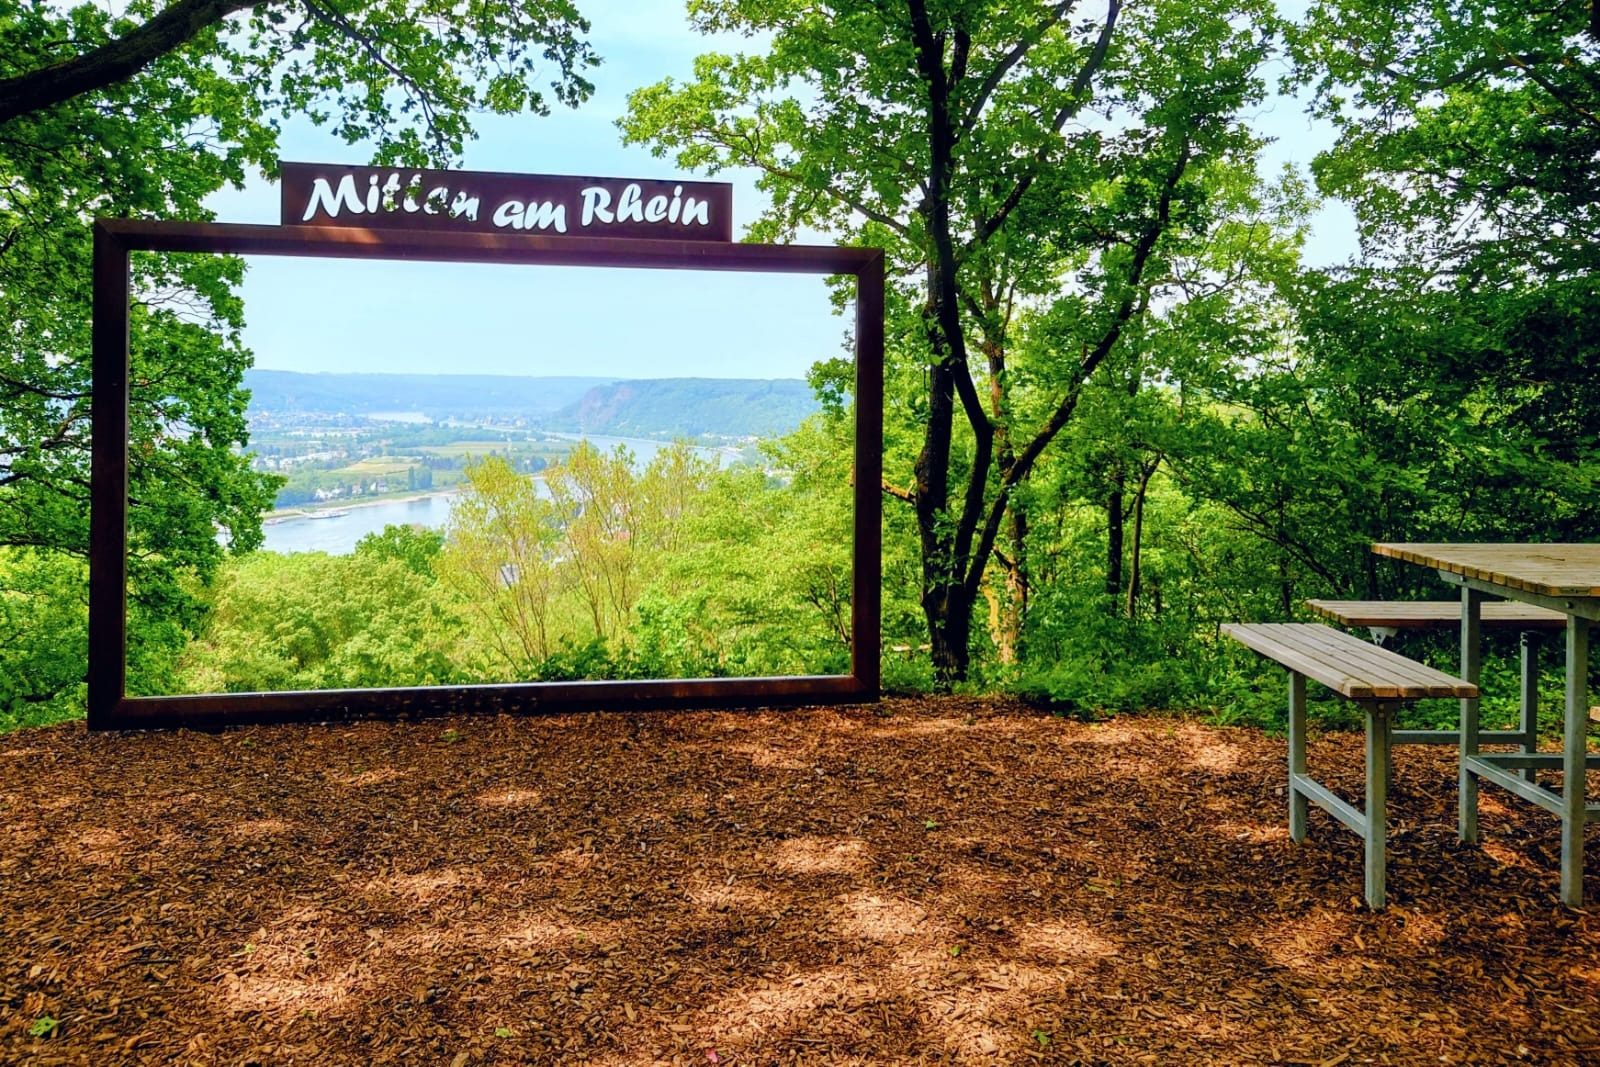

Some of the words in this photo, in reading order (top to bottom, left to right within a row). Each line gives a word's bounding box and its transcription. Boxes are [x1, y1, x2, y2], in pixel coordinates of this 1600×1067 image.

[302, 172, 480, 222] Mitten
[492, 200, 567, 233] am
[580, 183, 709, 226] Rhein
